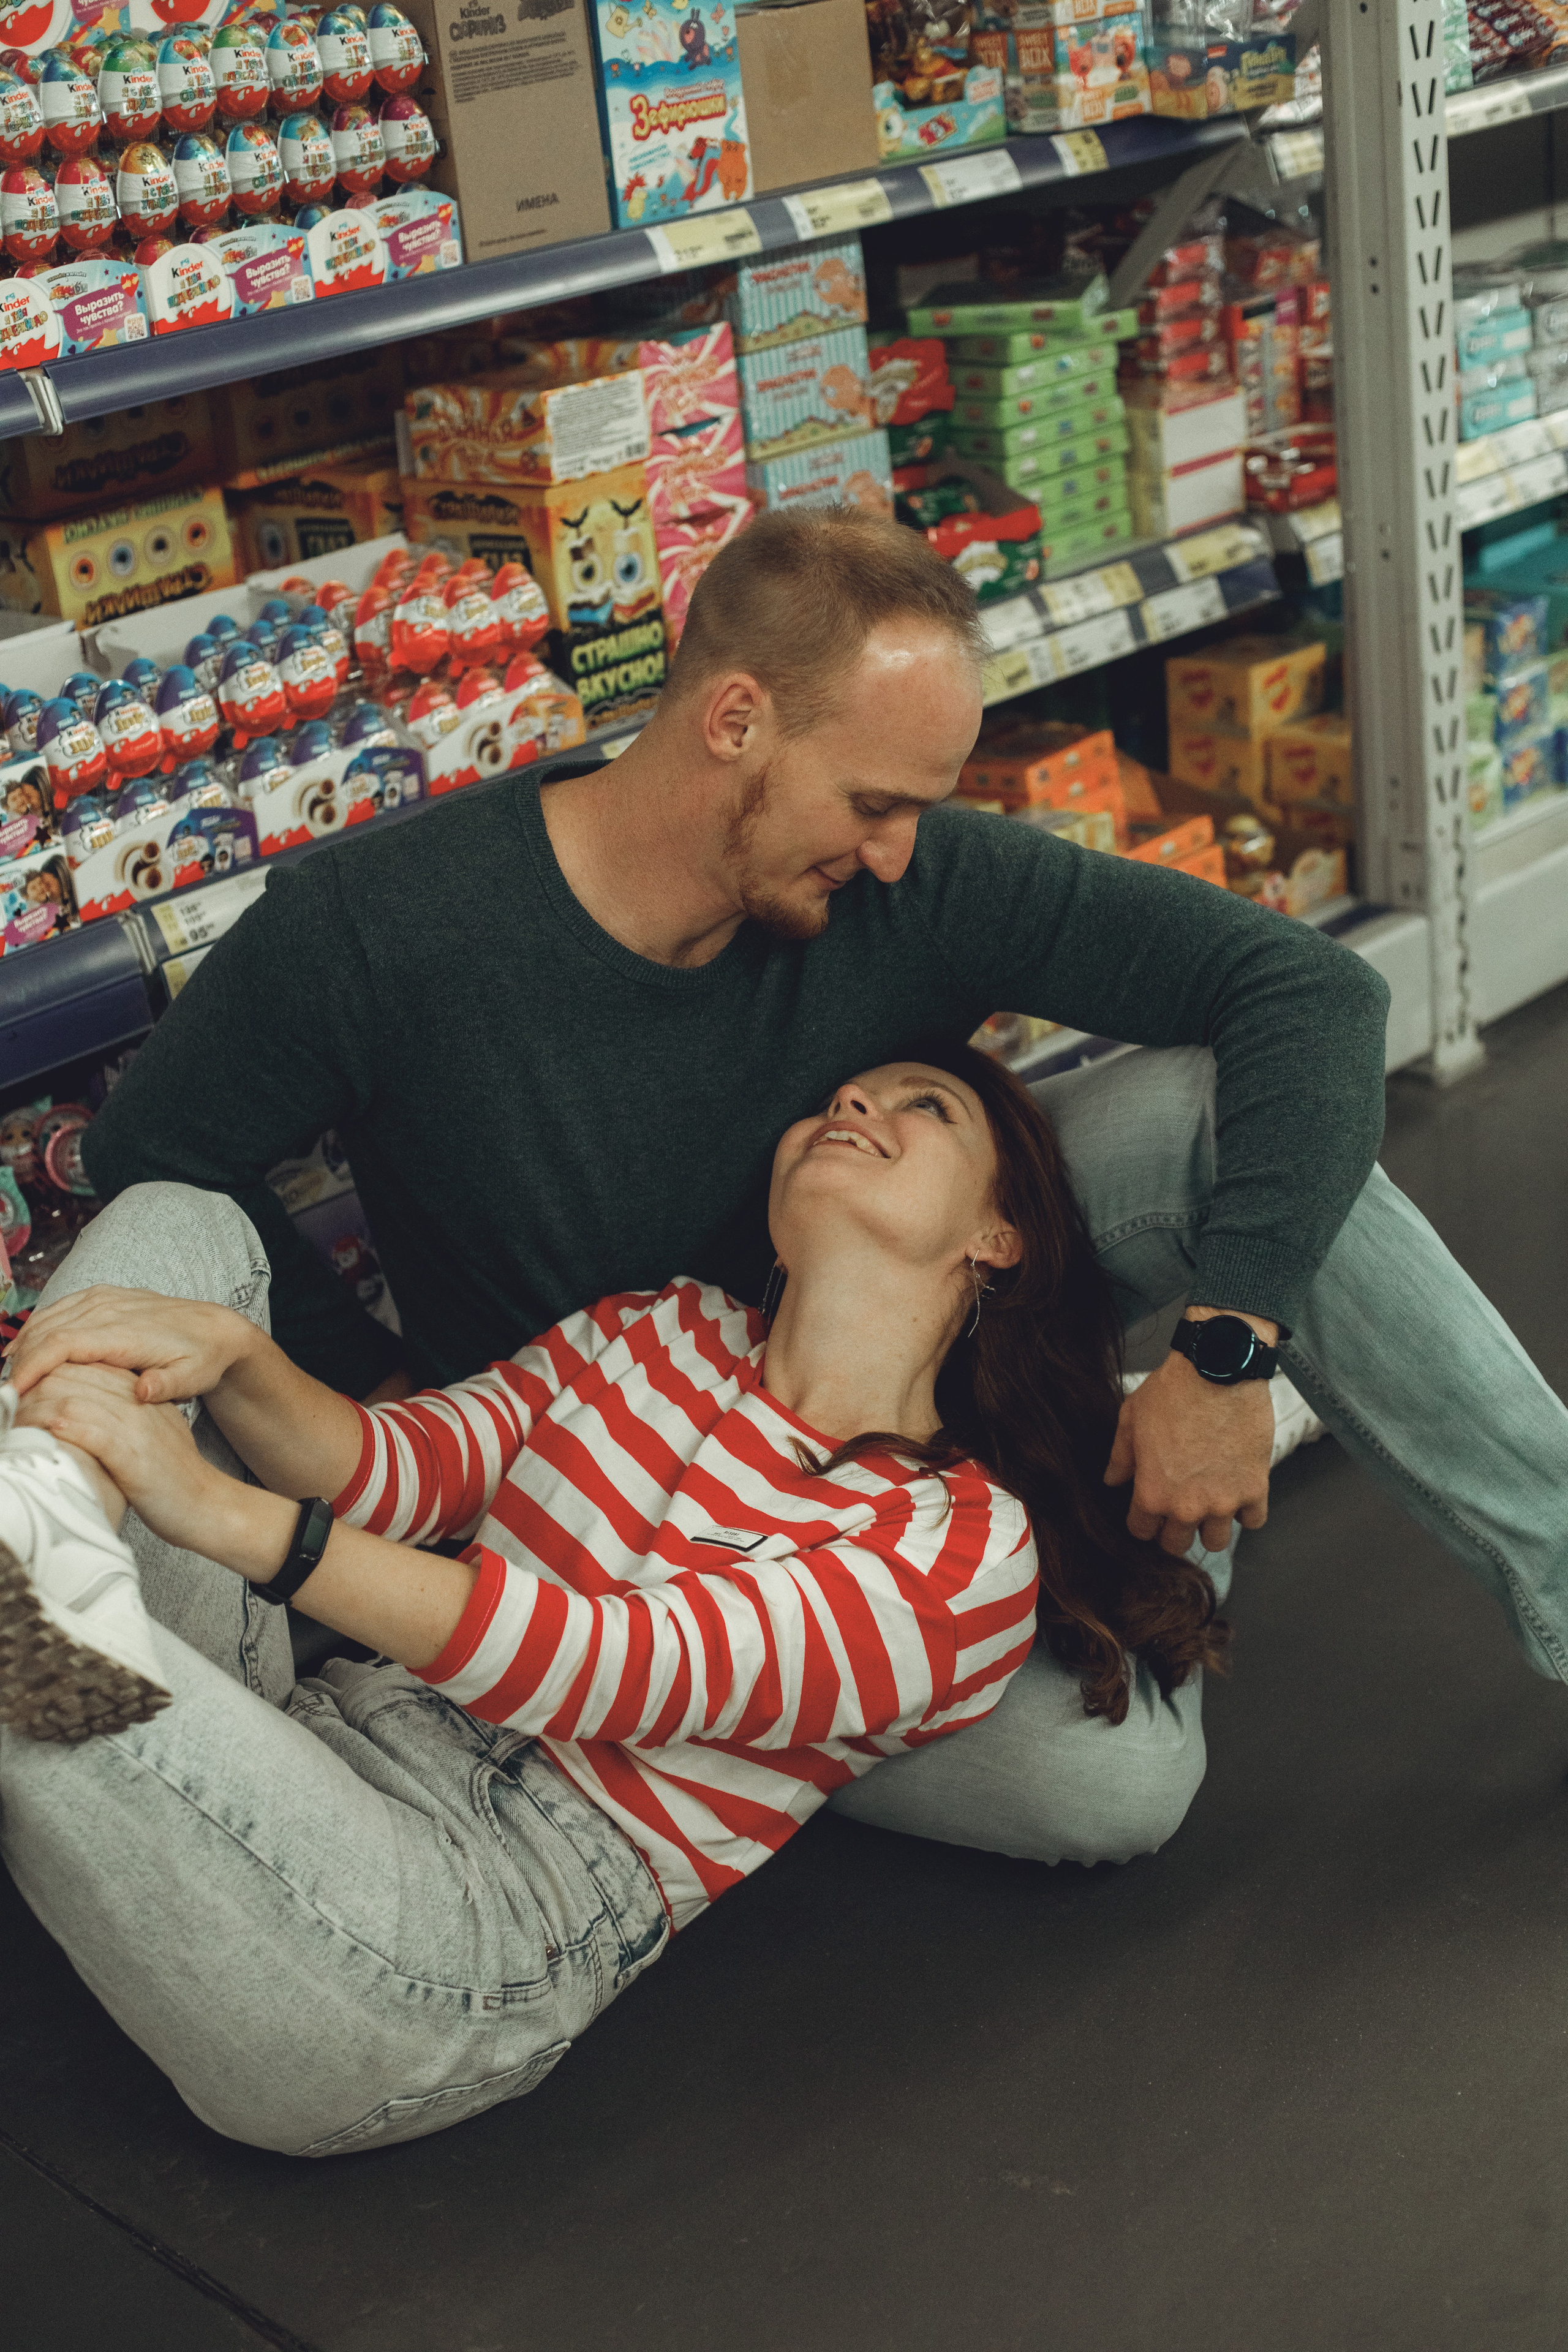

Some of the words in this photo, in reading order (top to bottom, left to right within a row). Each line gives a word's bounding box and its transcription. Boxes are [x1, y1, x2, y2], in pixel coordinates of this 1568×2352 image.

[460, 7, 490, 19] Kinder
[172, 260, 203, 278] Kinder
[246, 255, 292, 279] Выразить
[251, 263, 291, 288] чувства?
[74, 291, 125, 315] Выразить
[80, 301, 124, 325] чувства?
[0, 310, 48, 343] ДДЕРЖИВАЮ
[571, 621, 664, 673] СТРАШНО
